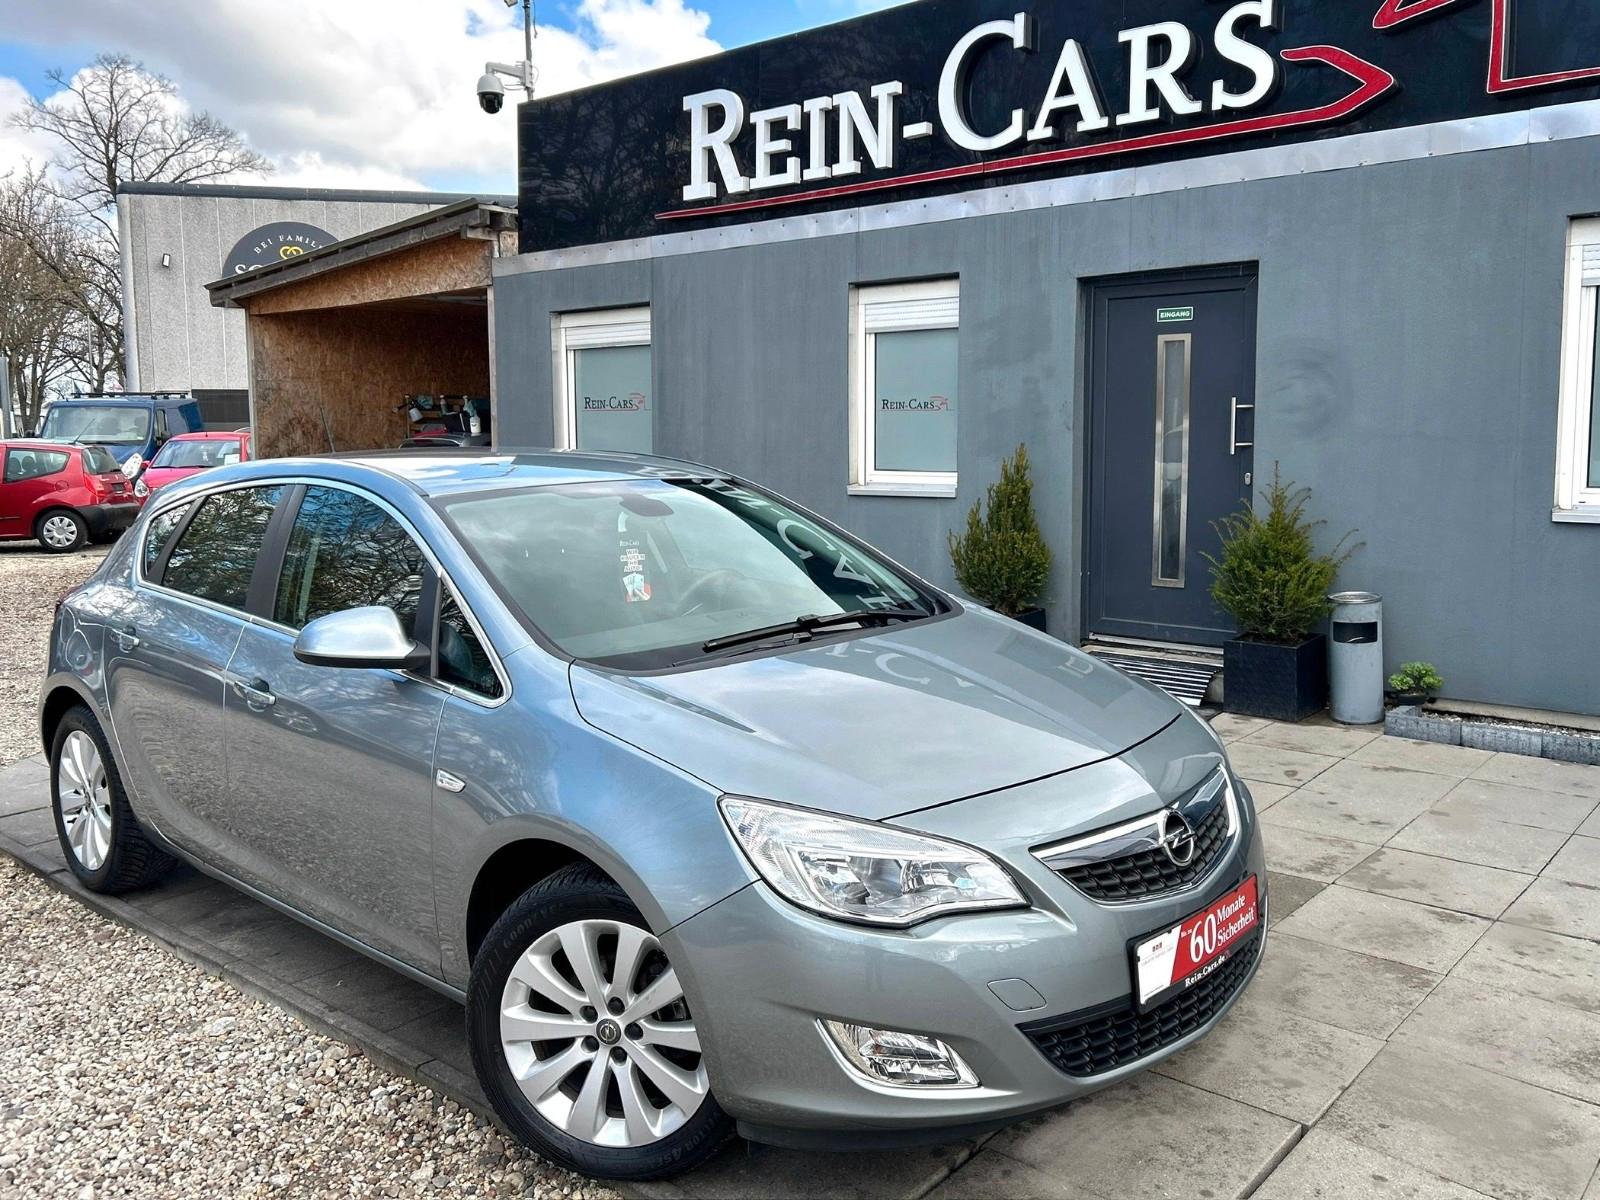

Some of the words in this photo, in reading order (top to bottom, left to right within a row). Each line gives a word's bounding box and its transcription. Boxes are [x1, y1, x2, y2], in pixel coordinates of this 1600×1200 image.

[254, 239, 273, 254] BEI
[1217, 894, 1245, 924] Monate
[1190, 913, 1216, 963] 60
[1184, 955, 1225, 987] Rein-Cars.de
